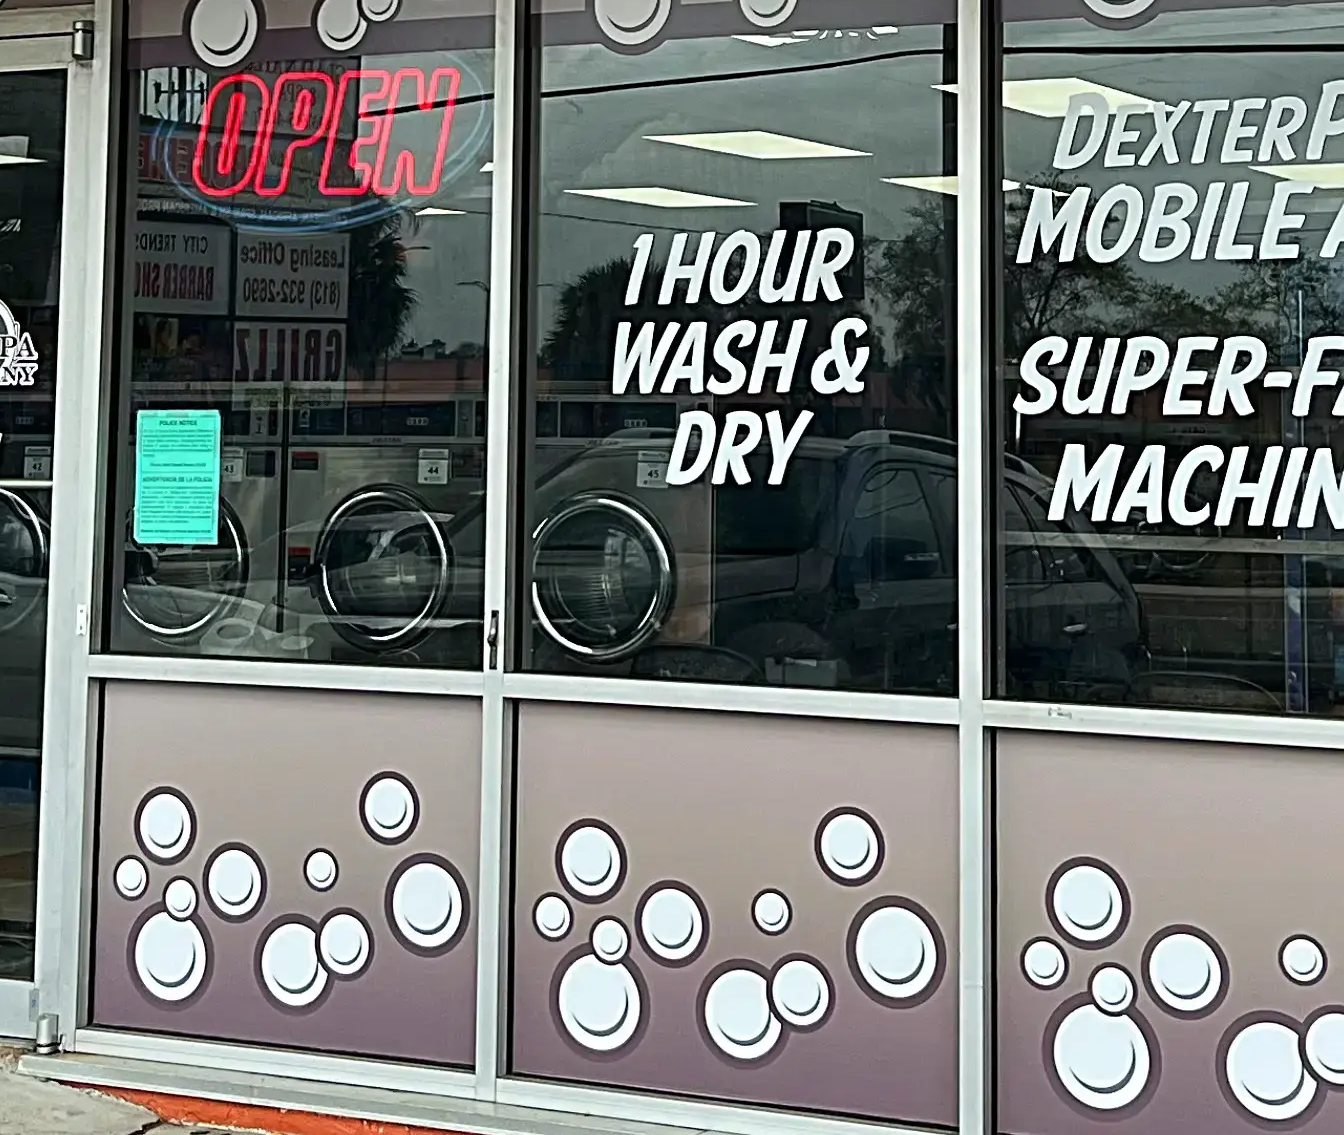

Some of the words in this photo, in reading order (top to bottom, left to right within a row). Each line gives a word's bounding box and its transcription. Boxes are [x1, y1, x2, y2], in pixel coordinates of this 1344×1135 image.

[192, 67, 462, 197] OPEN
[1015, 181, 1316, 264] MOBILE
[624, 232, 654, 306] 1
[657, 227, 855, 306] HOUR
[612, 318, 809, 395] WASH
[809, 317, 871, 395] &
[665, 409, 815, 486] DRY
